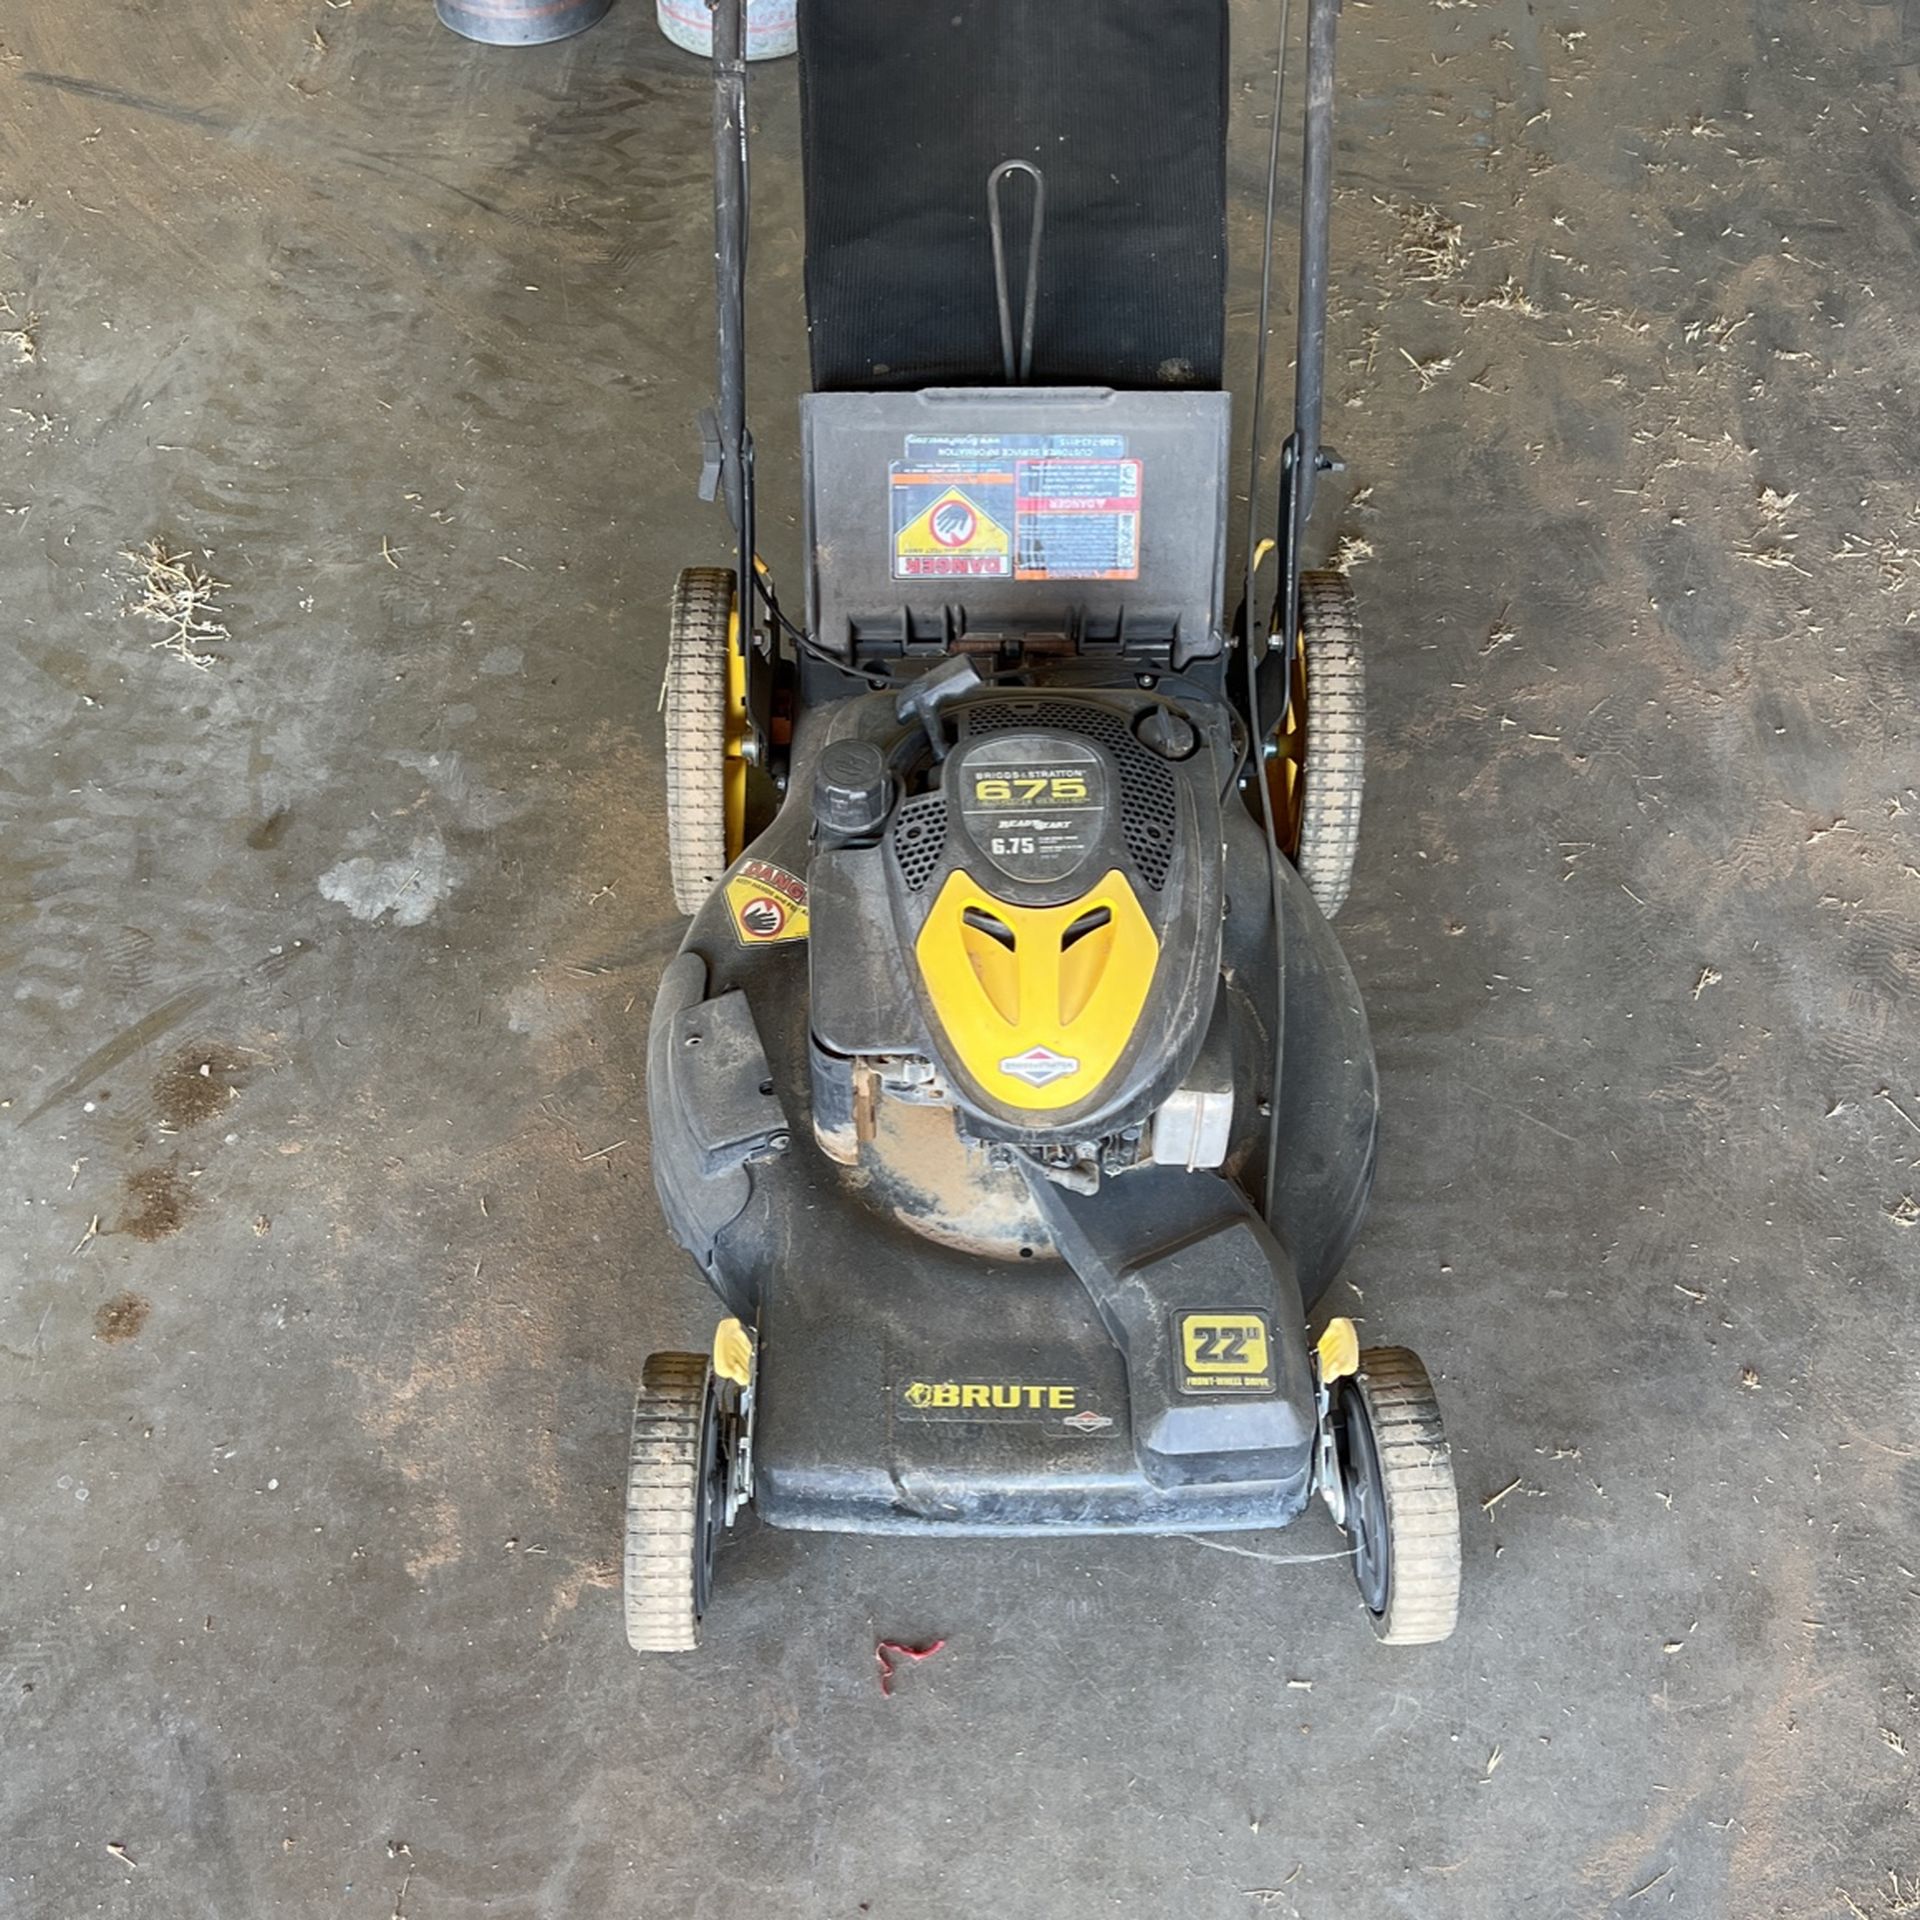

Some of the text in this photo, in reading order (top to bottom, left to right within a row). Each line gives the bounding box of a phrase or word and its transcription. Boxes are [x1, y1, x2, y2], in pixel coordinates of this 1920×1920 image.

[938, 448, 1000, 457] INFORMATION
[1003, 448, 1041, 457] SERVICE
[1049, 499, 1096, 510] DANGER
[905, 558, 1001, 575] DANGER
[977, 778, 1087, 801] 675
[992, 837, 1035, 855] 6.75
[745, 862, 809, 906] DANG
[931, 1383, 1076, 1409] BRUTE
